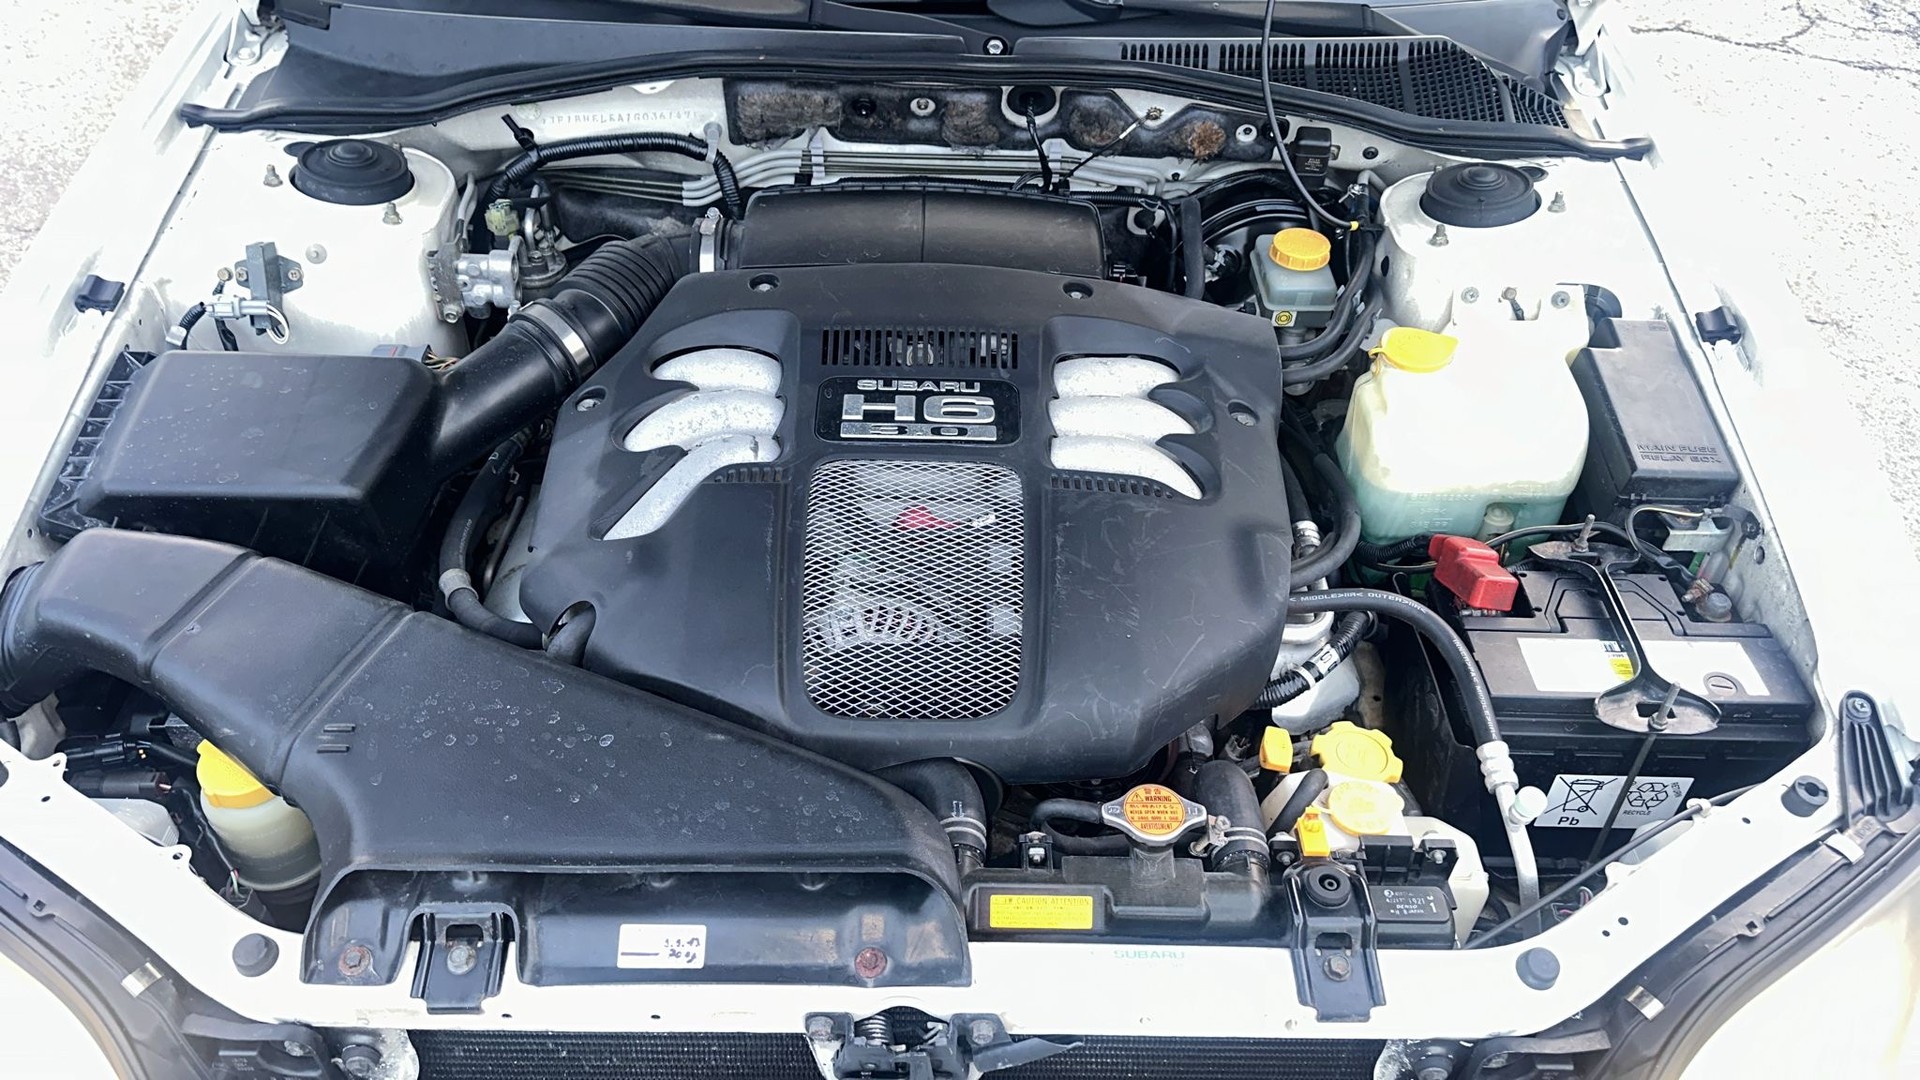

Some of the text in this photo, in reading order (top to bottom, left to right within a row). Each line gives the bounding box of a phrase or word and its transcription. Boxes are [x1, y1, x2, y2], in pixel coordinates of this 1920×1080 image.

[856, 379, 981, 393] SUBARU
[841, 393, 996, 424] H6
[1636, 443, 1717, 453] MAIN FUSE
[1640, 454, 1722, 463] RELAY BOX
[1557, 816, 1580, 826] Pb
[1016, 897, 1048, 905] CAUTION
[1050, 897, 1089, 905] ATTENTION
[1113, 950, 1185, 959] SUBARU
